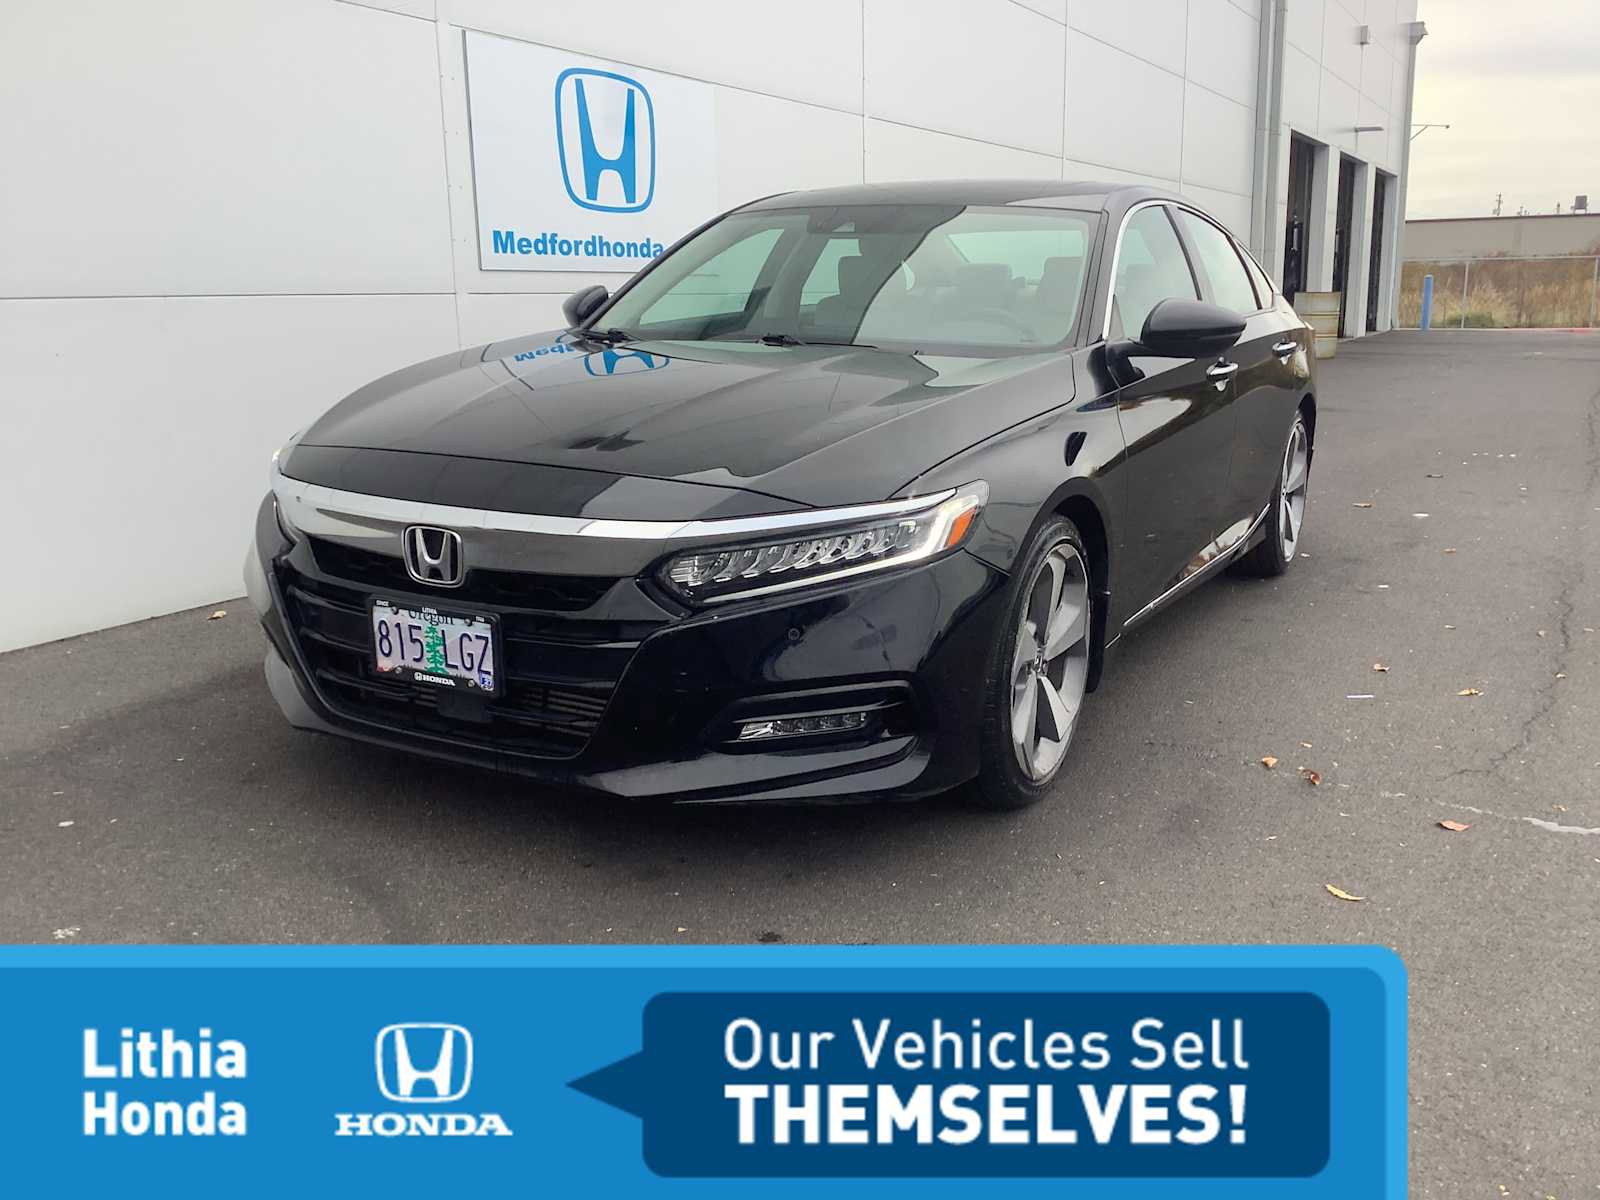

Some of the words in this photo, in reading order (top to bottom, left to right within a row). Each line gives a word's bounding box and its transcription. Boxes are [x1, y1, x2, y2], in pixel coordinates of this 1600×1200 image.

[492, 229, 664, 258] Medfordhonda
[378, 619, 424, 663] 815
[441, 629, 491, 675] LGZ
[422, 676, 455, 687] HONDA
